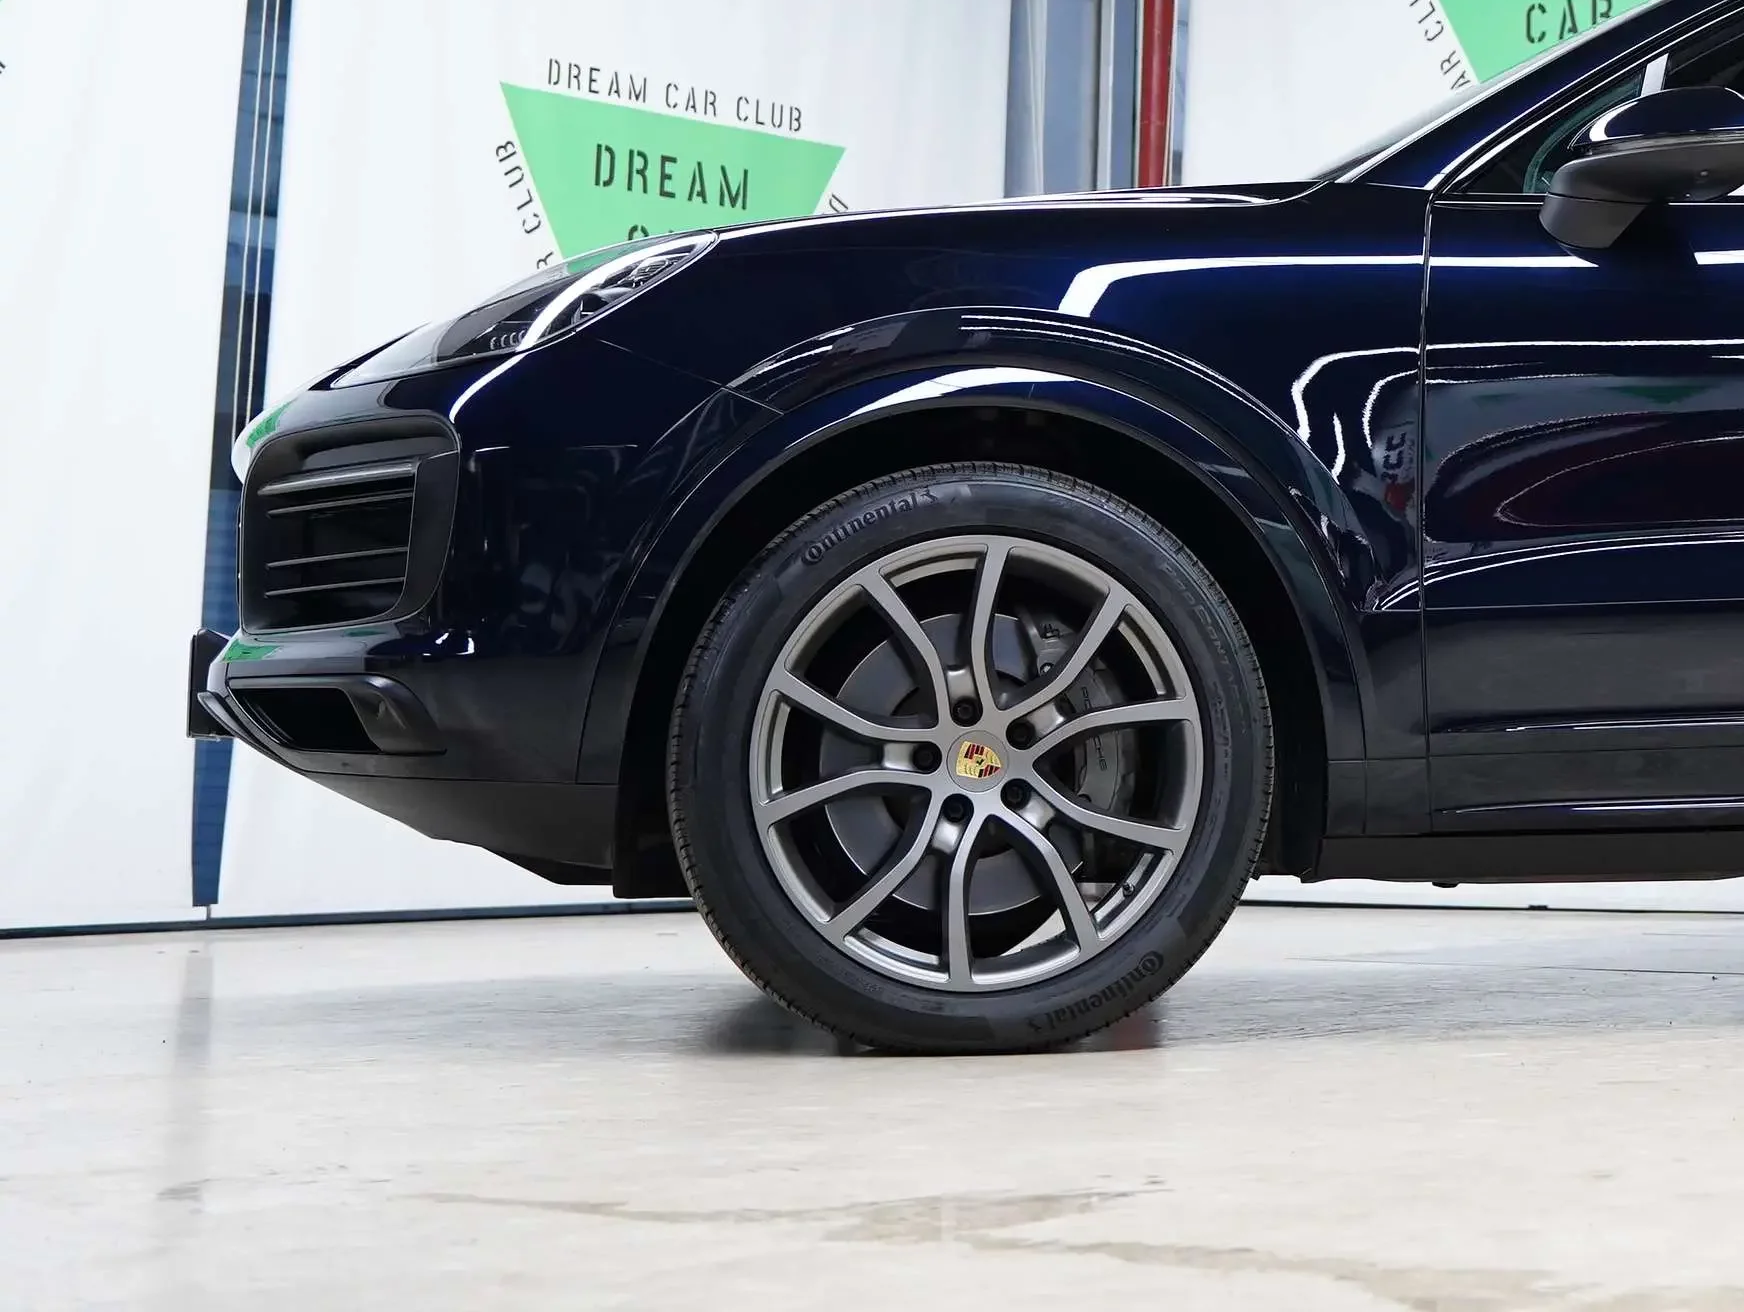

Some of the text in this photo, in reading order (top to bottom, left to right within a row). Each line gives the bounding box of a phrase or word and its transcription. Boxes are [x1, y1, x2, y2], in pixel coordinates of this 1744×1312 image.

[547, 58, 803, 133] DREAM CAR CLUB
[1440, 50, 1472, 90] AR
[495, 140, 542, 235] CLUB
[594, 142, 750, 211] DREAM
[801, 492, 919, 566] Continental
[1044, 949, 1165, 1031] Continental
